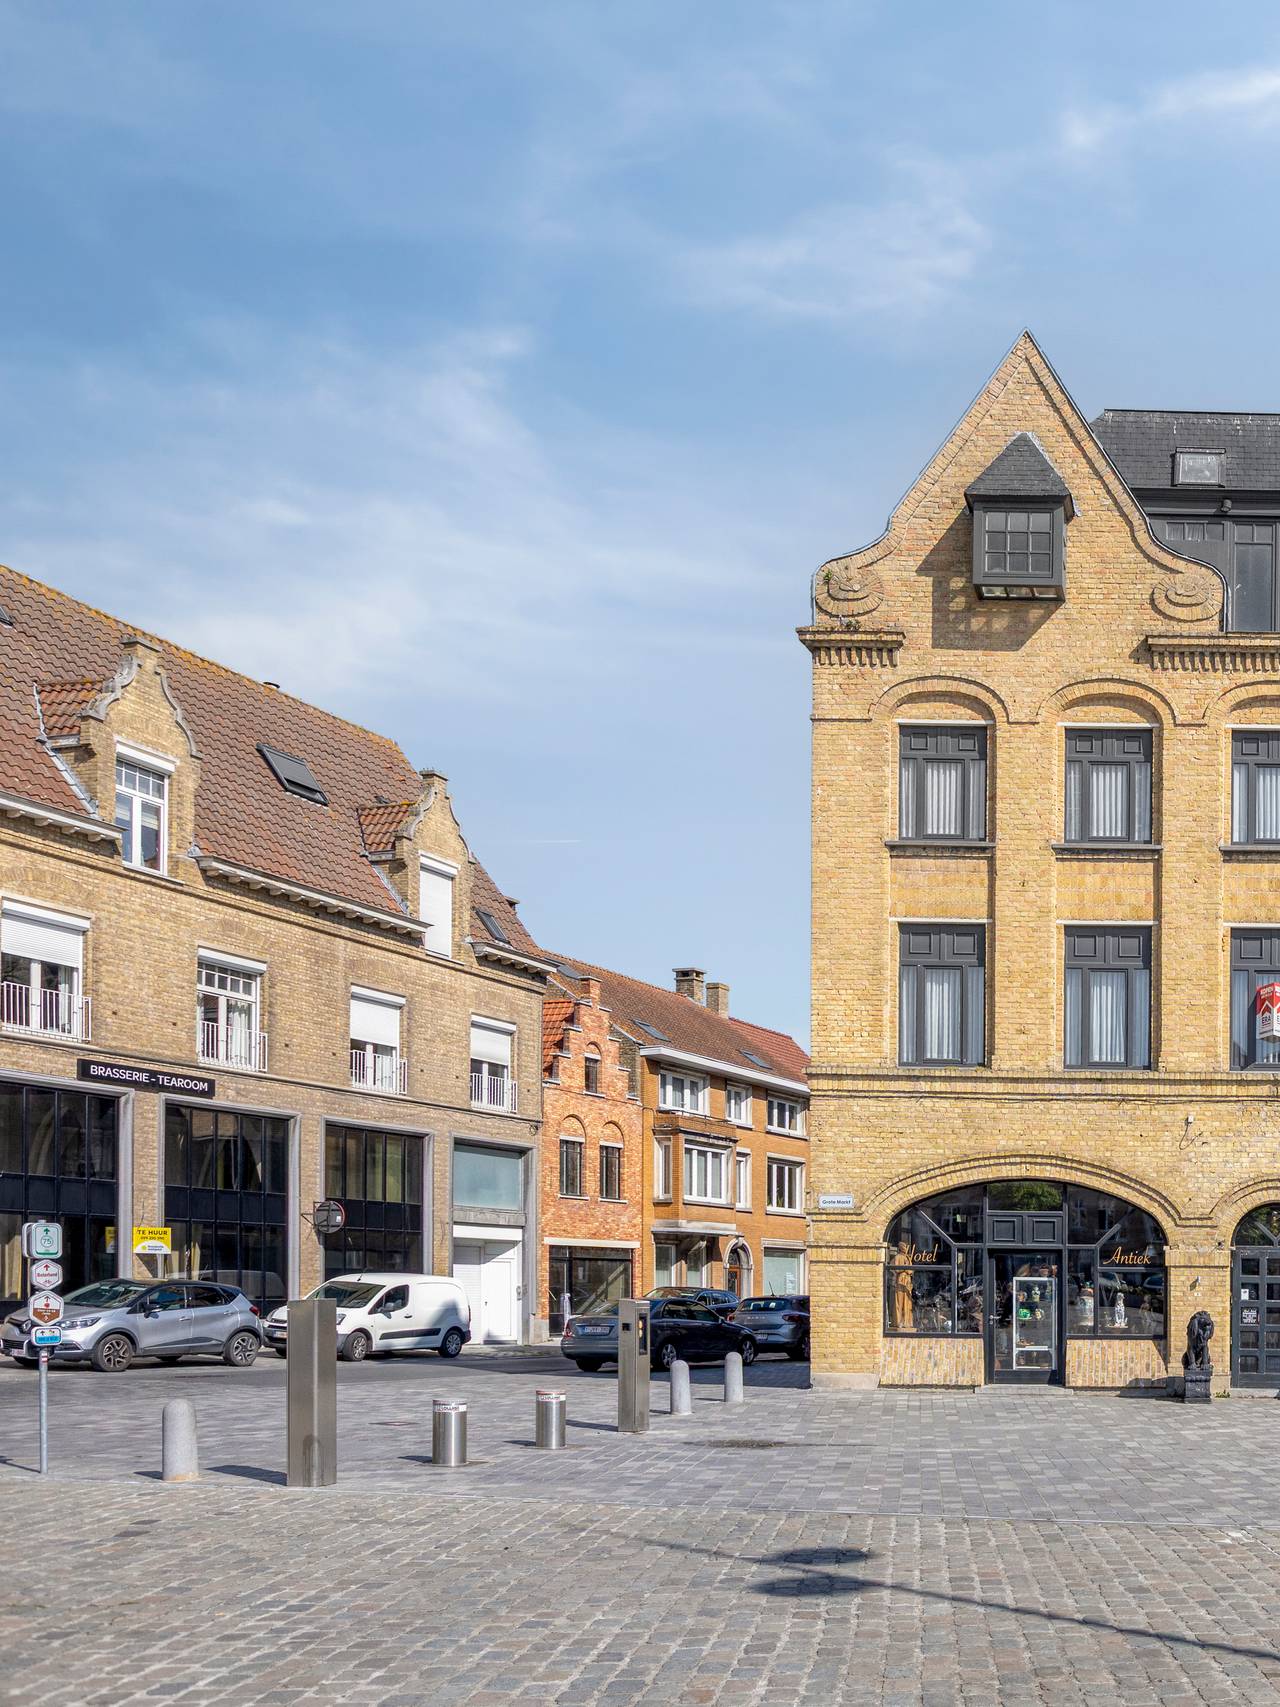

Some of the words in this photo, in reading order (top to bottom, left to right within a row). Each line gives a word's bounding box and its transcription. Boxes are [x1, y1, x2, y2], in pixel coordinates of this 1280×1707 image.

[90, 1064, 150, 1083] BRASSERIE
[157, 1075, 208, 1092] TEAROOM
[900, 1243, 939, 1263] Hotel
[1102, 1245, 1152, 1265] Antiek
